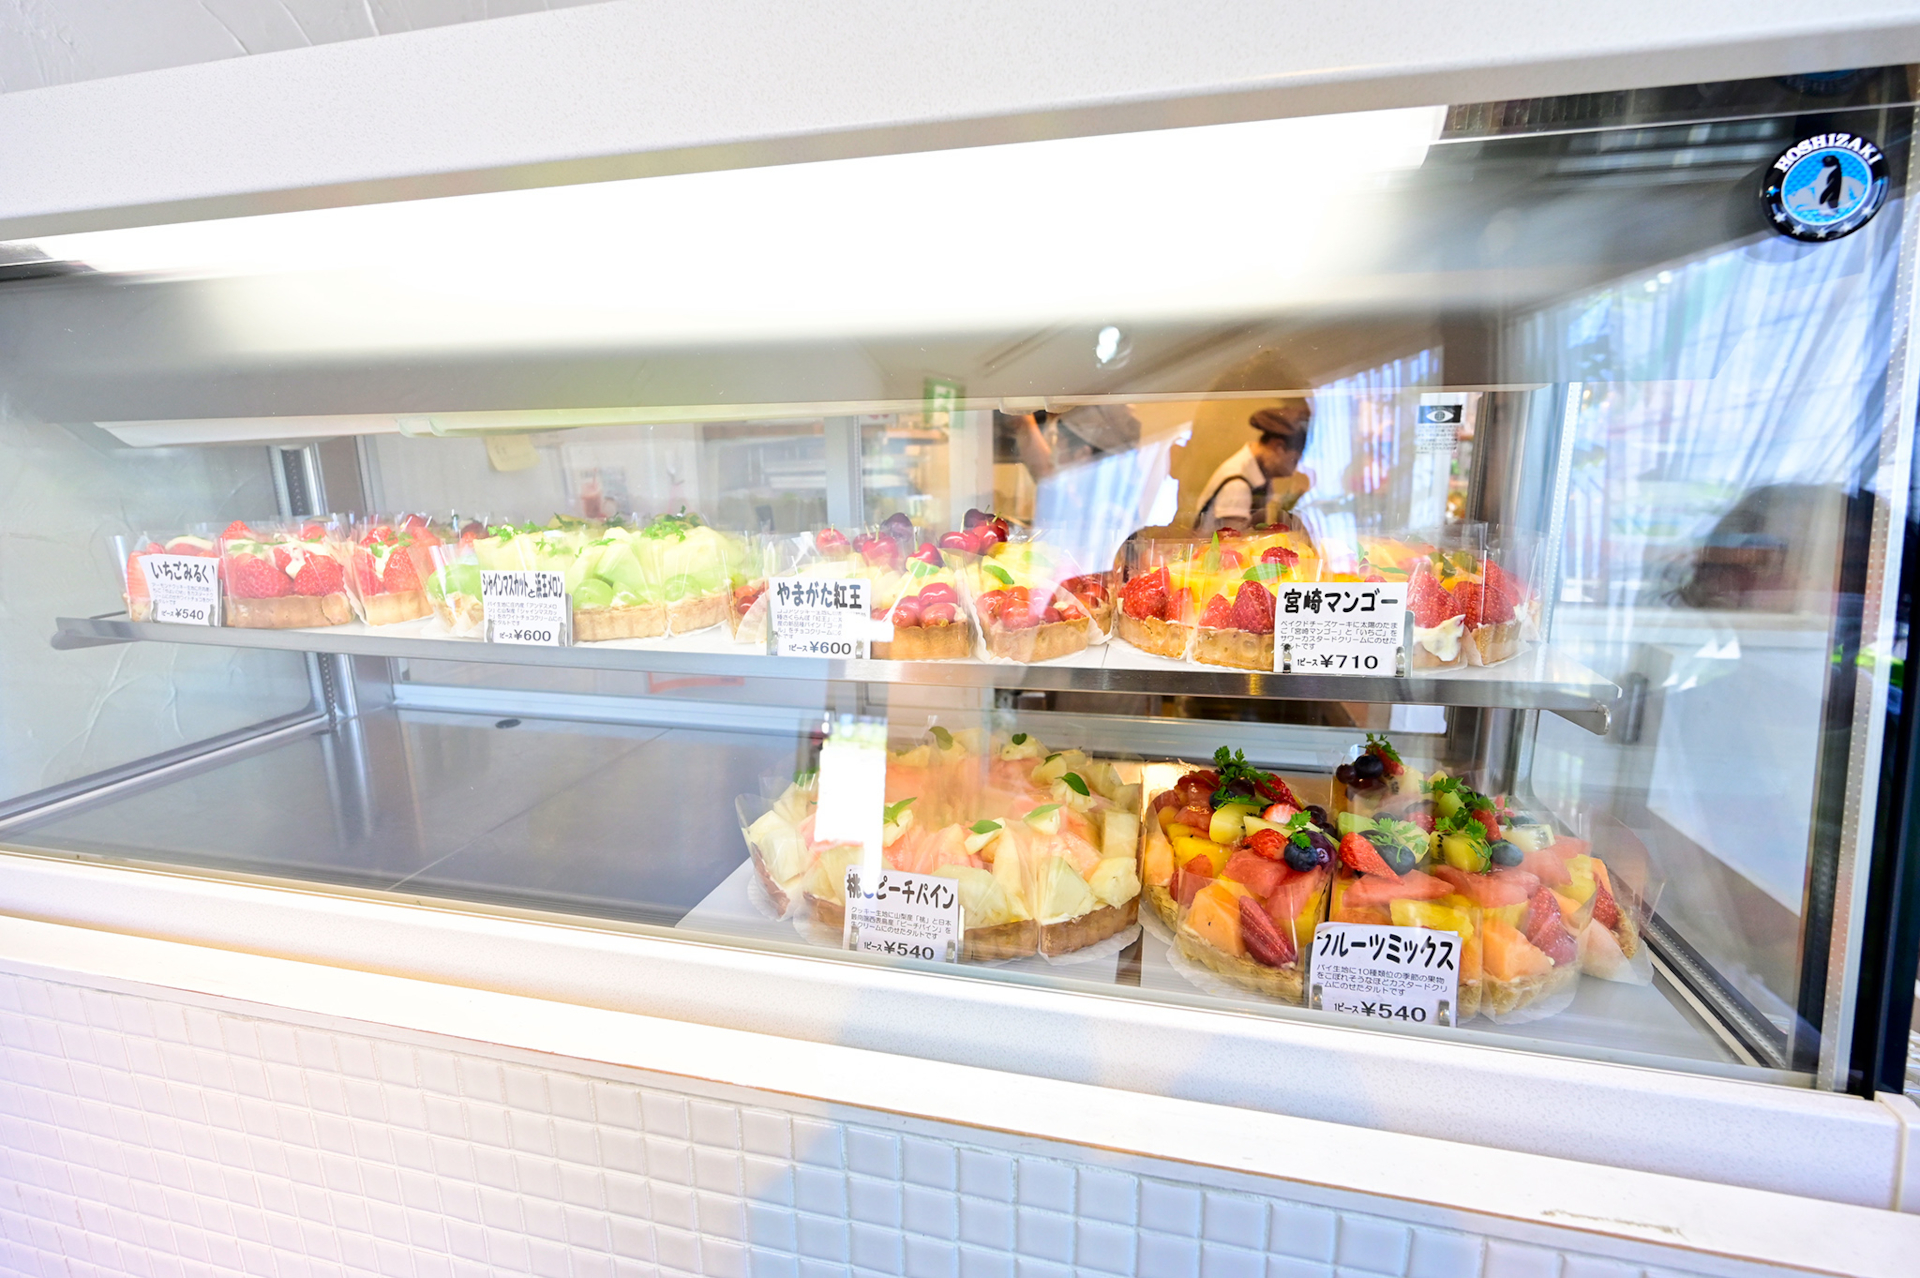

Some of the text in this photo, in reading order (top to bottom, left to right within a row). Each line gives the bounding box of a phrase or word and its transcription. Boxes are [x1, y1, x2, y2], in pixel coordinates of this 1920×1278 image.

[1773, 133, 1883, 173] HOSHIZAKI
[777, 581, 862, 609] やまがた紅王
[1284, 588, 1398, 614] 宮崎マンゴー
[175, 608, 204, 620] ¥540
[514, 629, 551, 641] ¥600
[1281, 635, 1397, 645] サワーカスタードクリームにのせた
[810, 641, 851, 655] ¥600
[1320, 654, 1378, 669] ¥710
[884, 940, 934, 960] ¥540
[1317, 930, 1454, 970] フルーツミックス
[1316, 970, 1448, 992] をこぼれそうなほどカスタードクリ
[1361, 1001, 1426, 1022] ¥540
